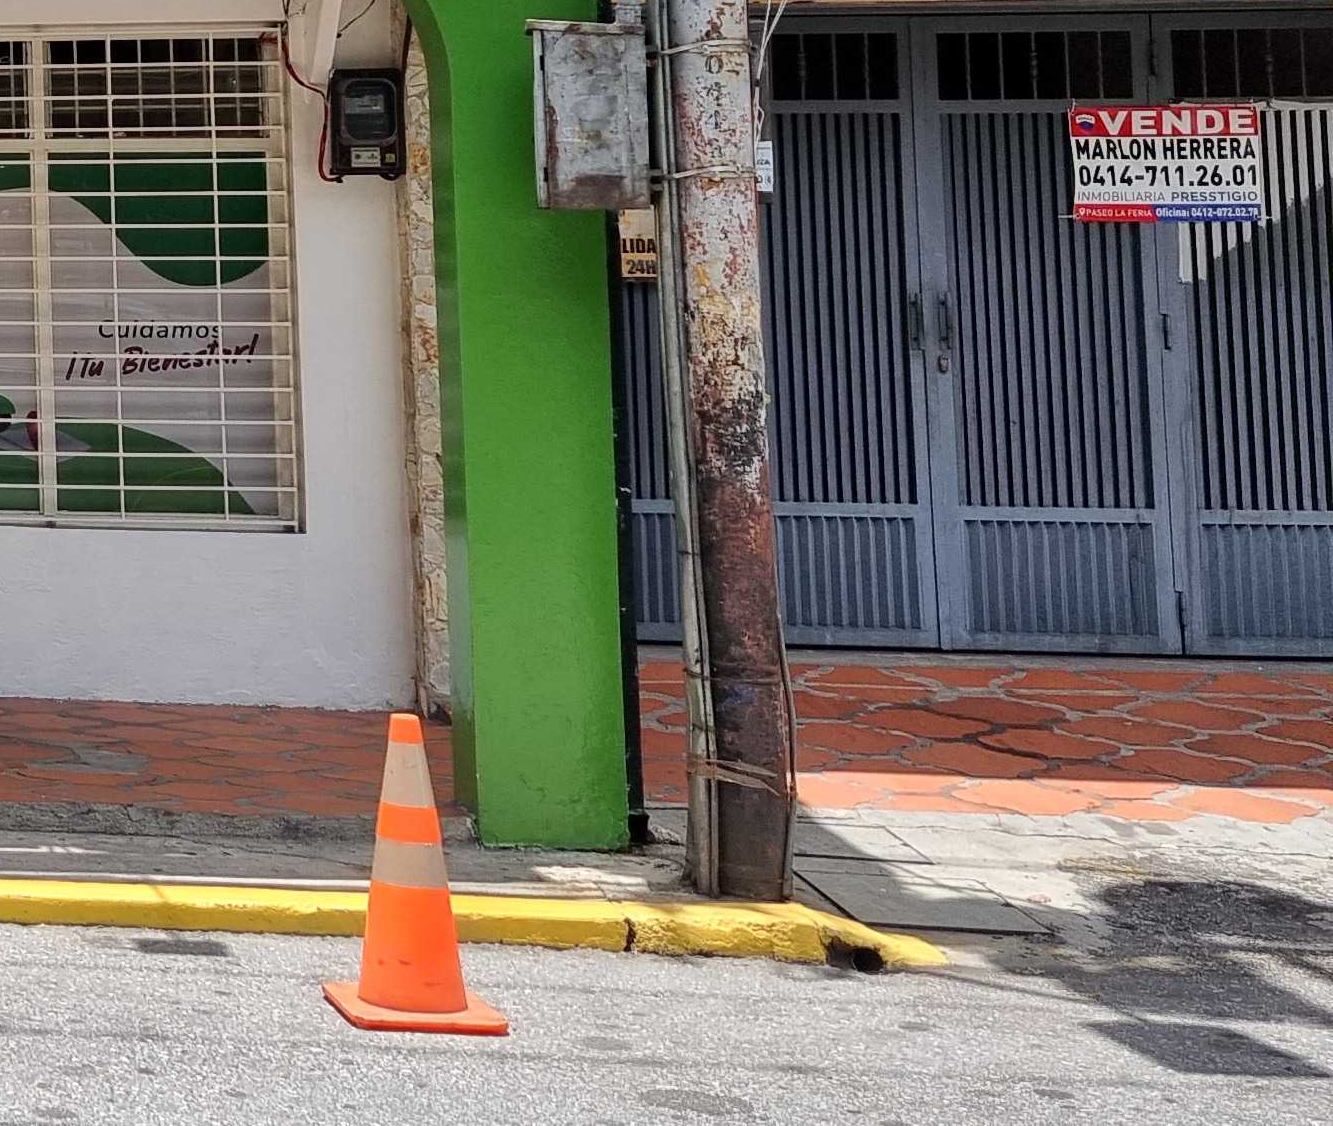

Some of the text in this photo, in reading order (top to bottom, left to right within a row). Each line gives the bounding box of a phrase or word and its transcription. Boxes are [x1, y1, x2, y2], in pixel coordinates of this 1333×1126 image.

[1097, 109, 1255, 135] VENDE
[1075, 137, 1256, 160] MARLON HERRERA
[1078, 164, 1257, 187] 0414-711.26.01
[1077, 191, 1258, 202] INMOBILIARIA PRESSTIGIO
[1086, 208, 1153, 217] PASEO LA FERIA
[622, 238, 656, 253] LIDA
[98, 319, 219, 339] Cuidamos
[122, 333, 259, 375] Bienestar!
